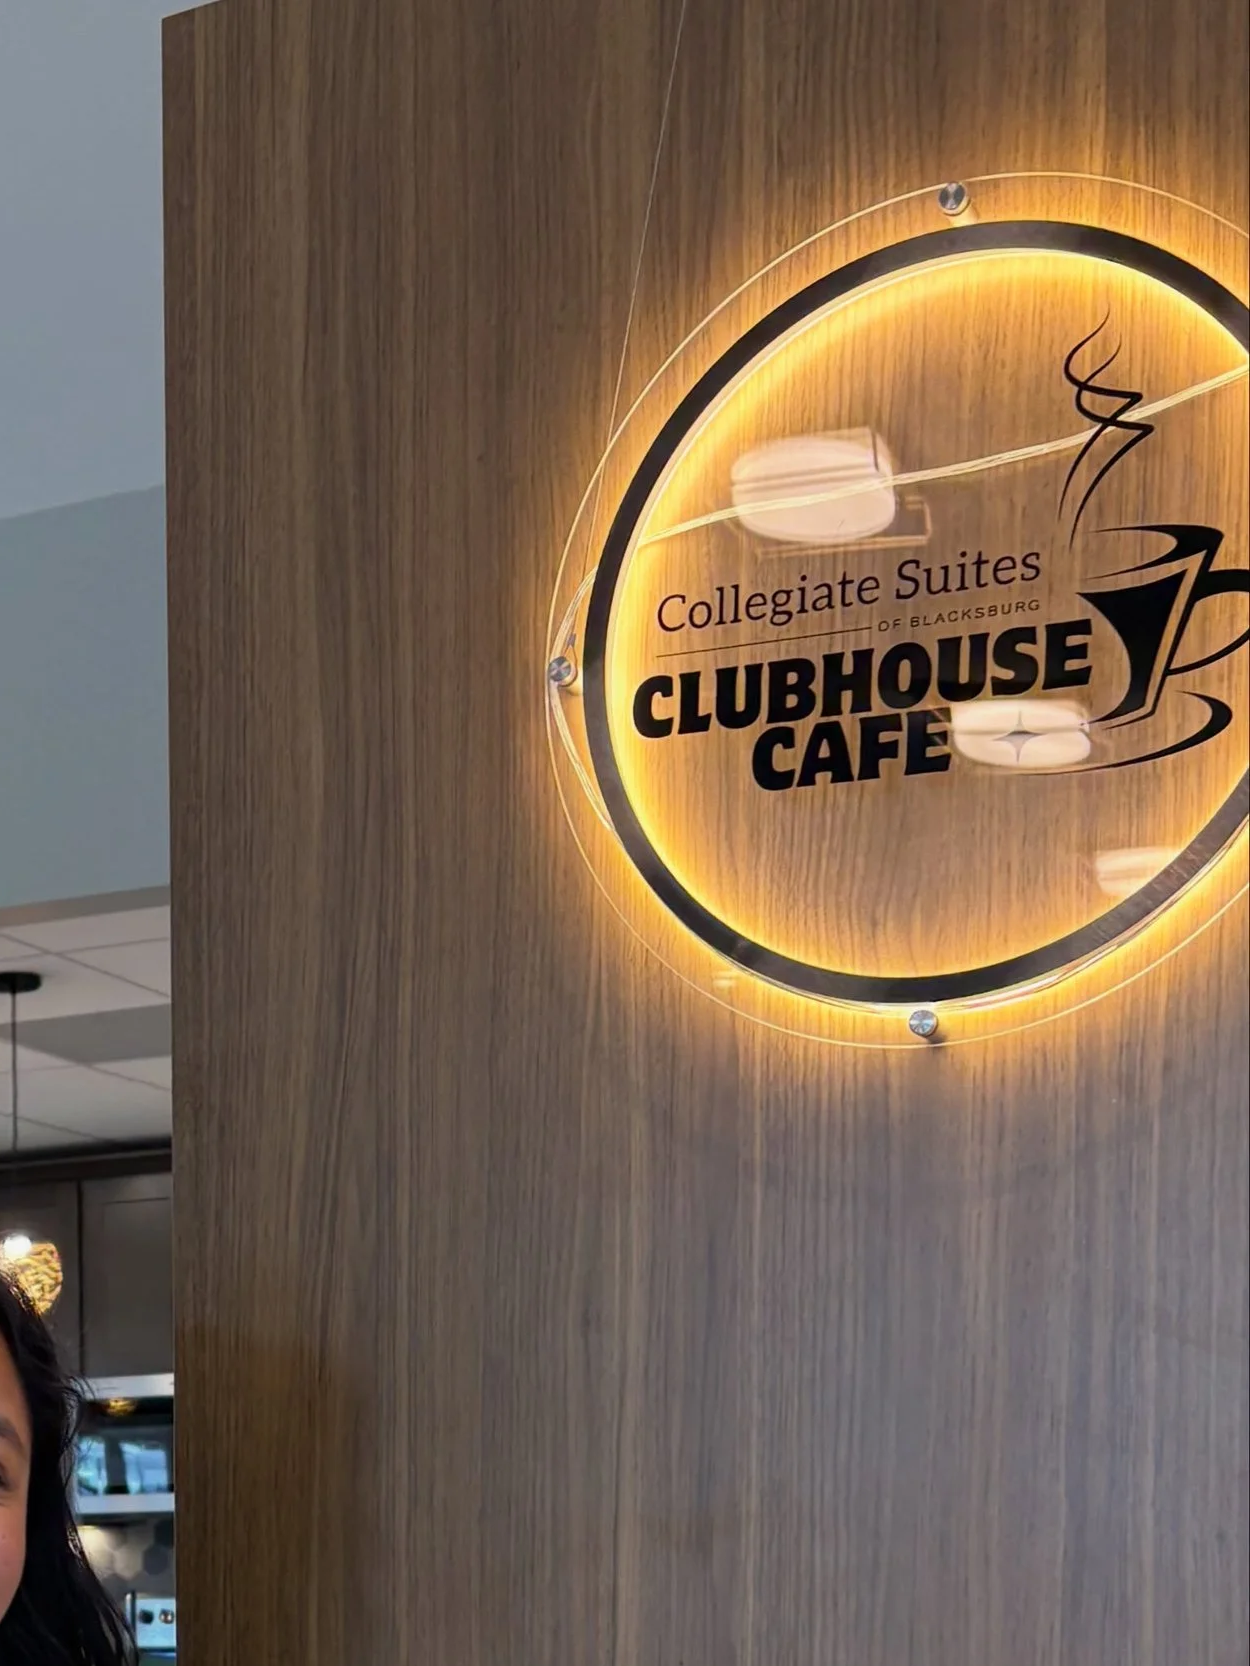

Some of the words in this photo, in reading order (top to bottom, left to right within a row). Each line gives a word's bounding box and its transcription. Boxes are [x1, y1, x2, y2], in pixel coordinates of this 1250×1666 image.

[657, 571, 880, 632] Collegiate
[895, 551, 1041, 600] Suites
[878, 619, 902, 633] OF
[910, 599, 1041, 628] BLACKSBURG
[633, 619, 1092, 738] CLUBHOUSE
[753, 707, 952, 791] CAFE
